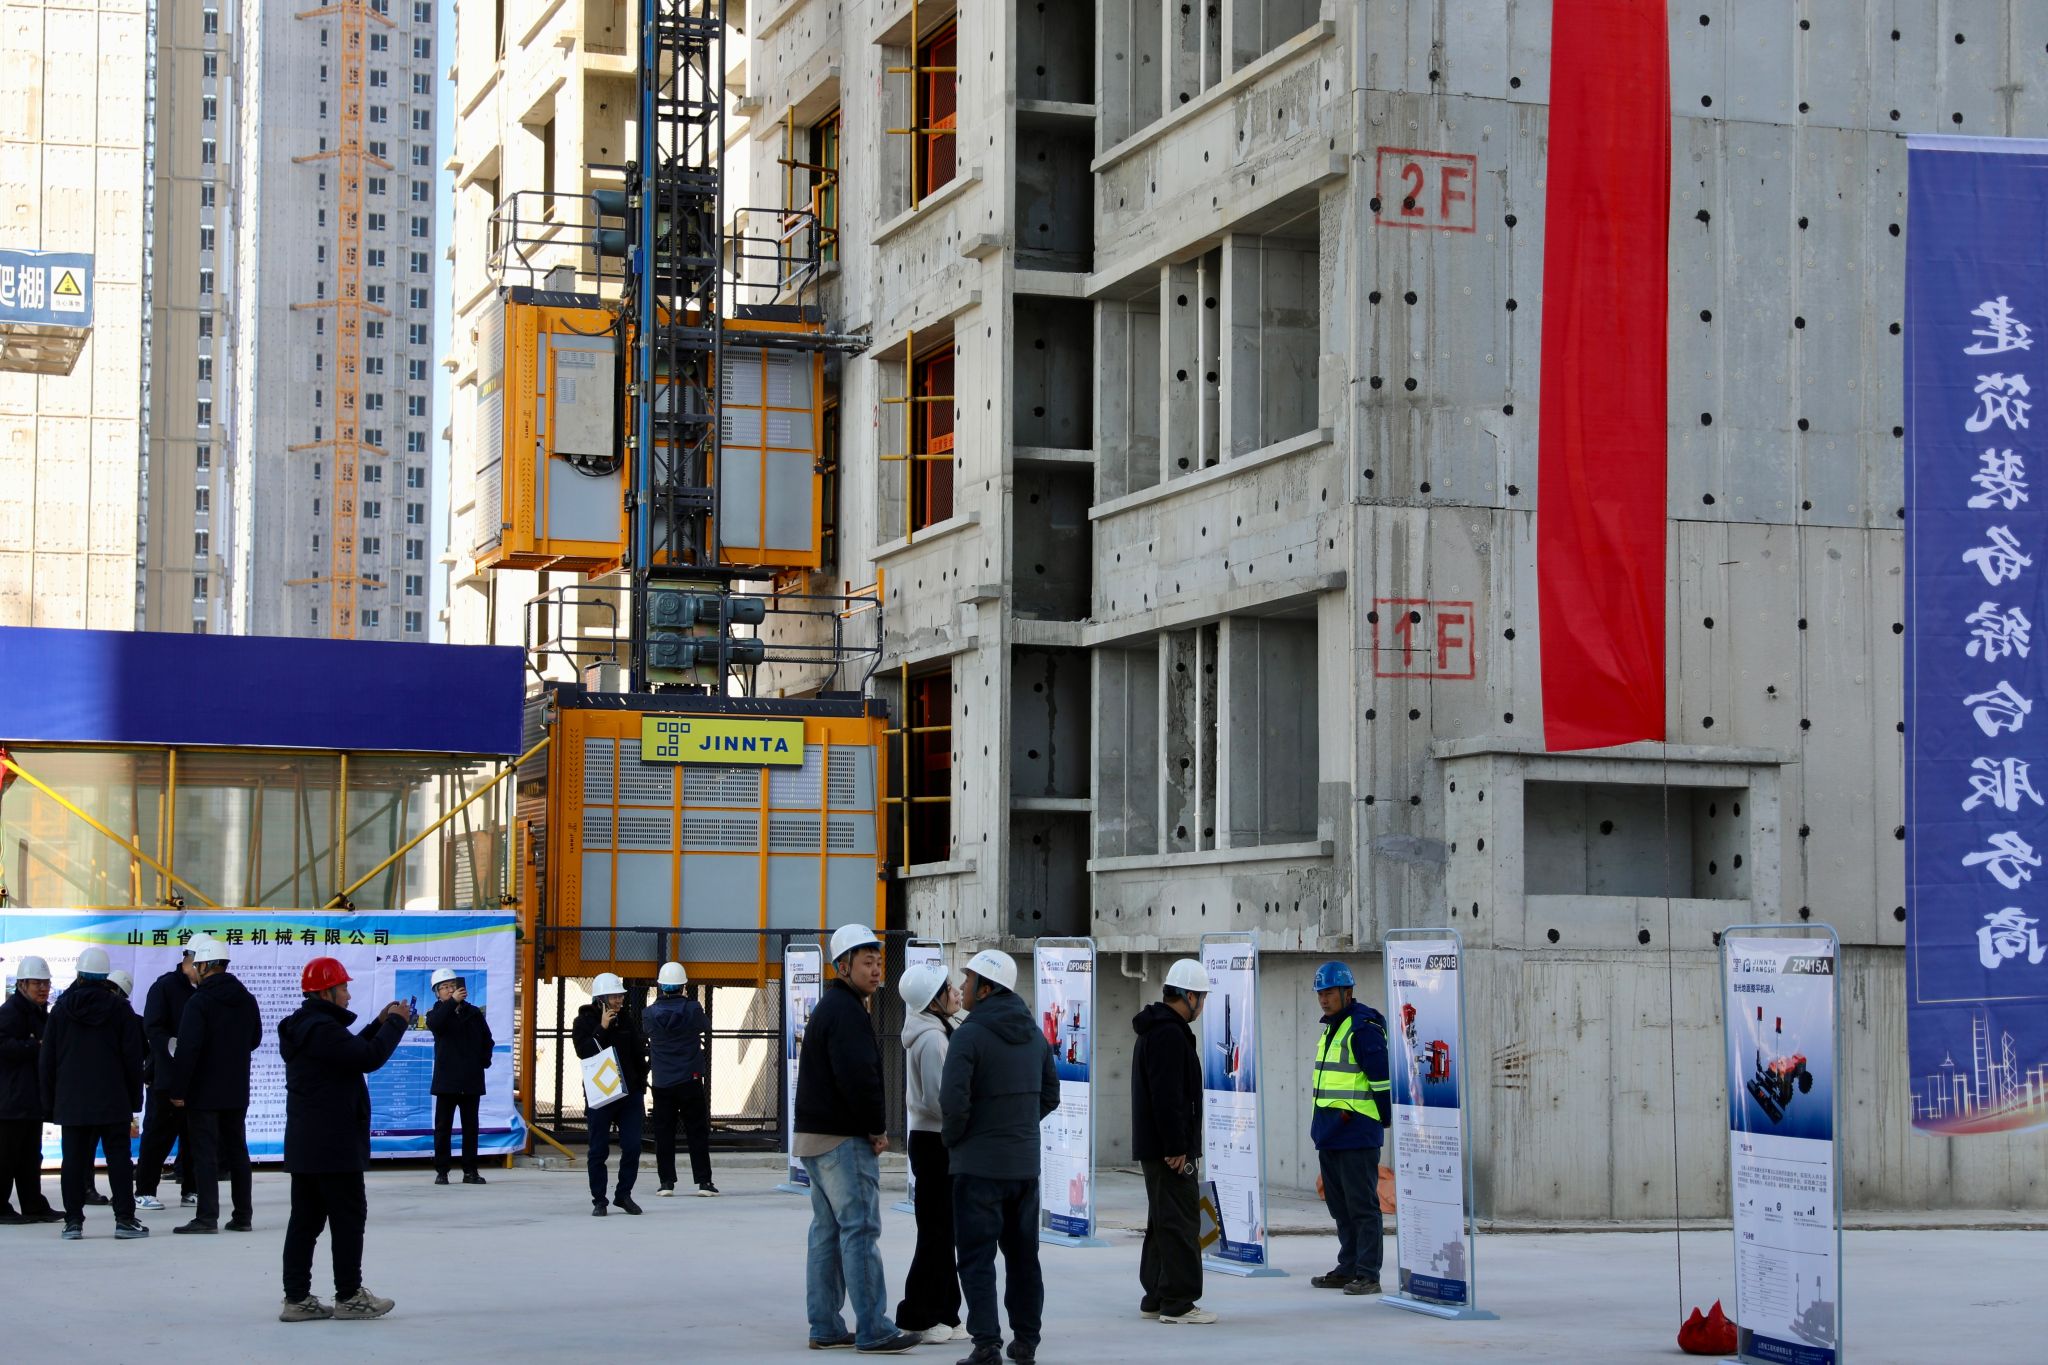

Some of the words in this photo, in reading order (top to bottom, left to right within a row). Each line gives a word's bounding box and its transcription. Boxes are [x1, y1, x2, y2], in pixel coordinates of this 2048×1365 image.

[1401, 162, 1470, 219] 2F
[1394, 611, 1466, 670] 1F
[699, 735, 789, 754] JINNTA
[1429, 956, 1457, 969] SC430B
[1792, 958, 1830, 973] ZP415A
